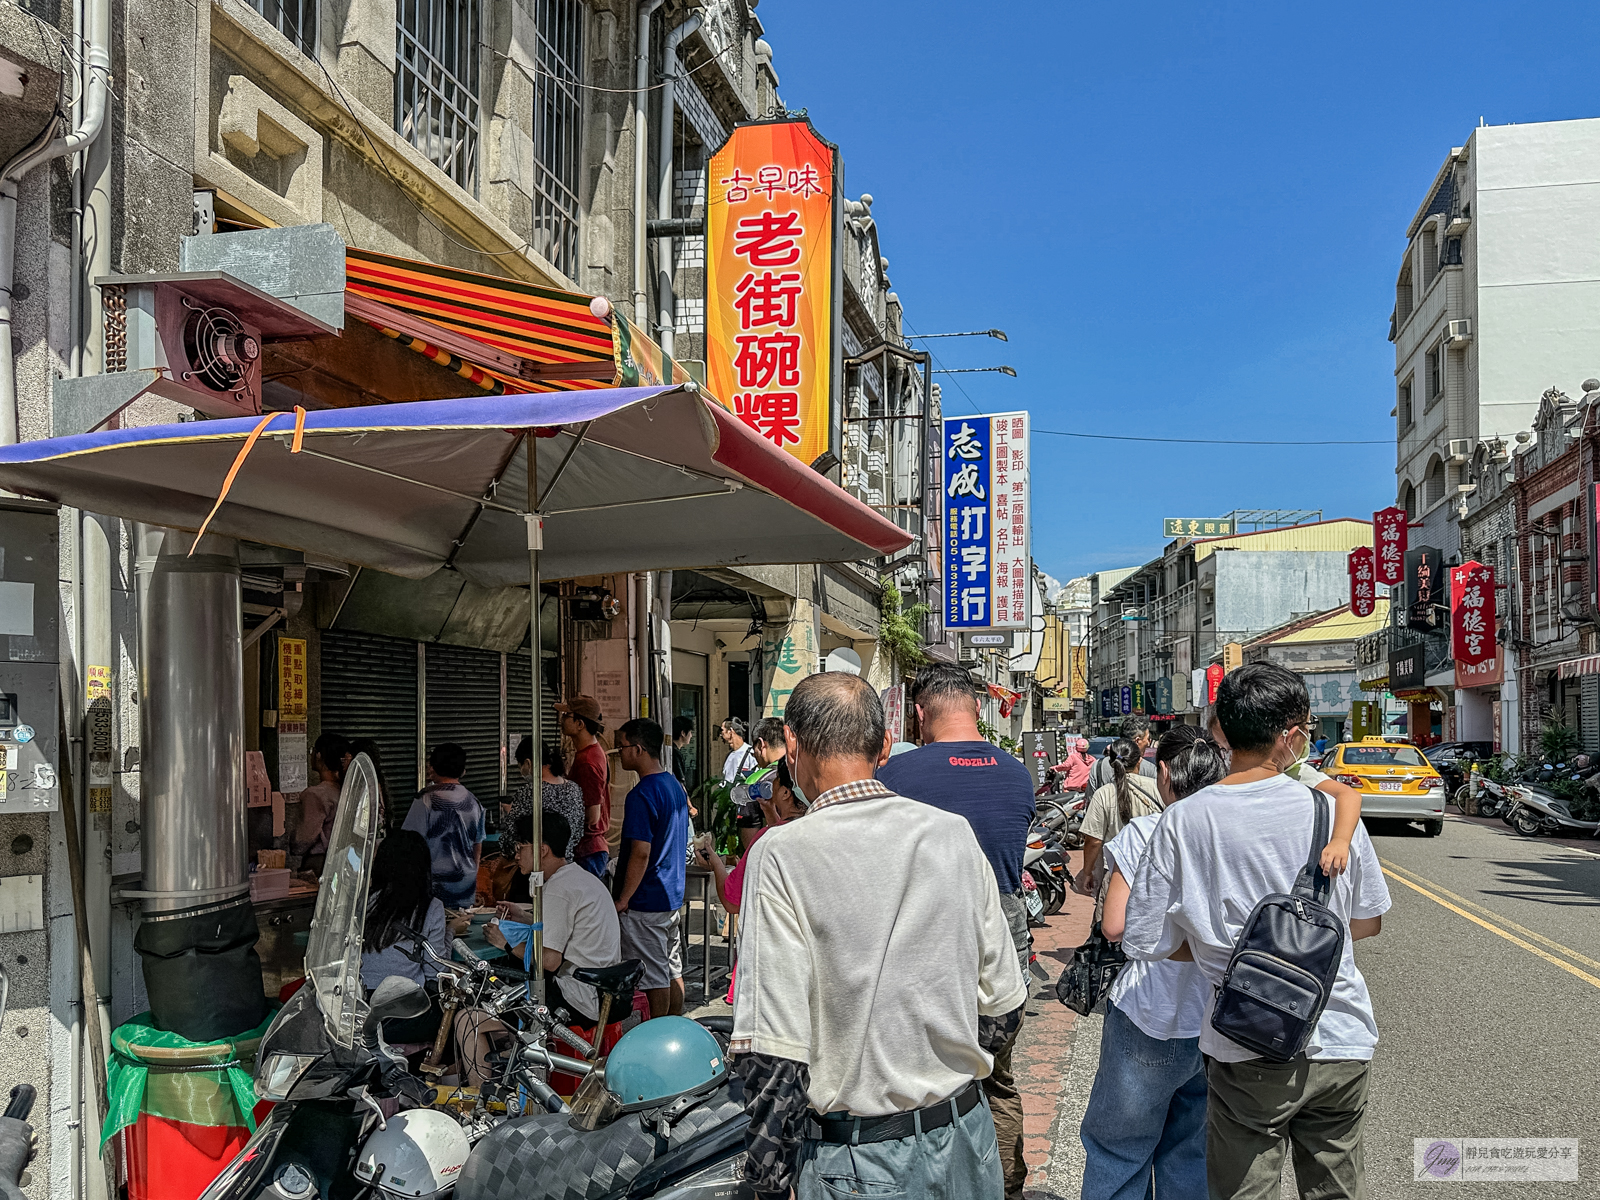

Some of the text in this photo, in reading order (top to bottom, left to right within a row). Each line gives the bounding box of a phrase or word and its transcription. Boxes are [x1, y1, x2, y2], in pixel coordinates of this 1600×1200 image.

[721, 164, 821, 202] 古早味
[734, 211, 803, 447] 老街碗粿
[996, 418, 1008, 622] 竣工圖製本 喜帖 名片 海報 護貝
[1012, 418, 1024, 622] 晒圖 影印 第二原圖輸出 大圖掃描存檔
[1376, 513, 1404, 523] 斗六市
[1381, 523, 1401, 580] 福德宮
[1455, 569, 1491, 584] 斗六市
[1355, 564, 1373, 615] 福德宮
[1462, 585, 1487, 656] 福德宮
[948, 756, 998, 767] GODZILLA
